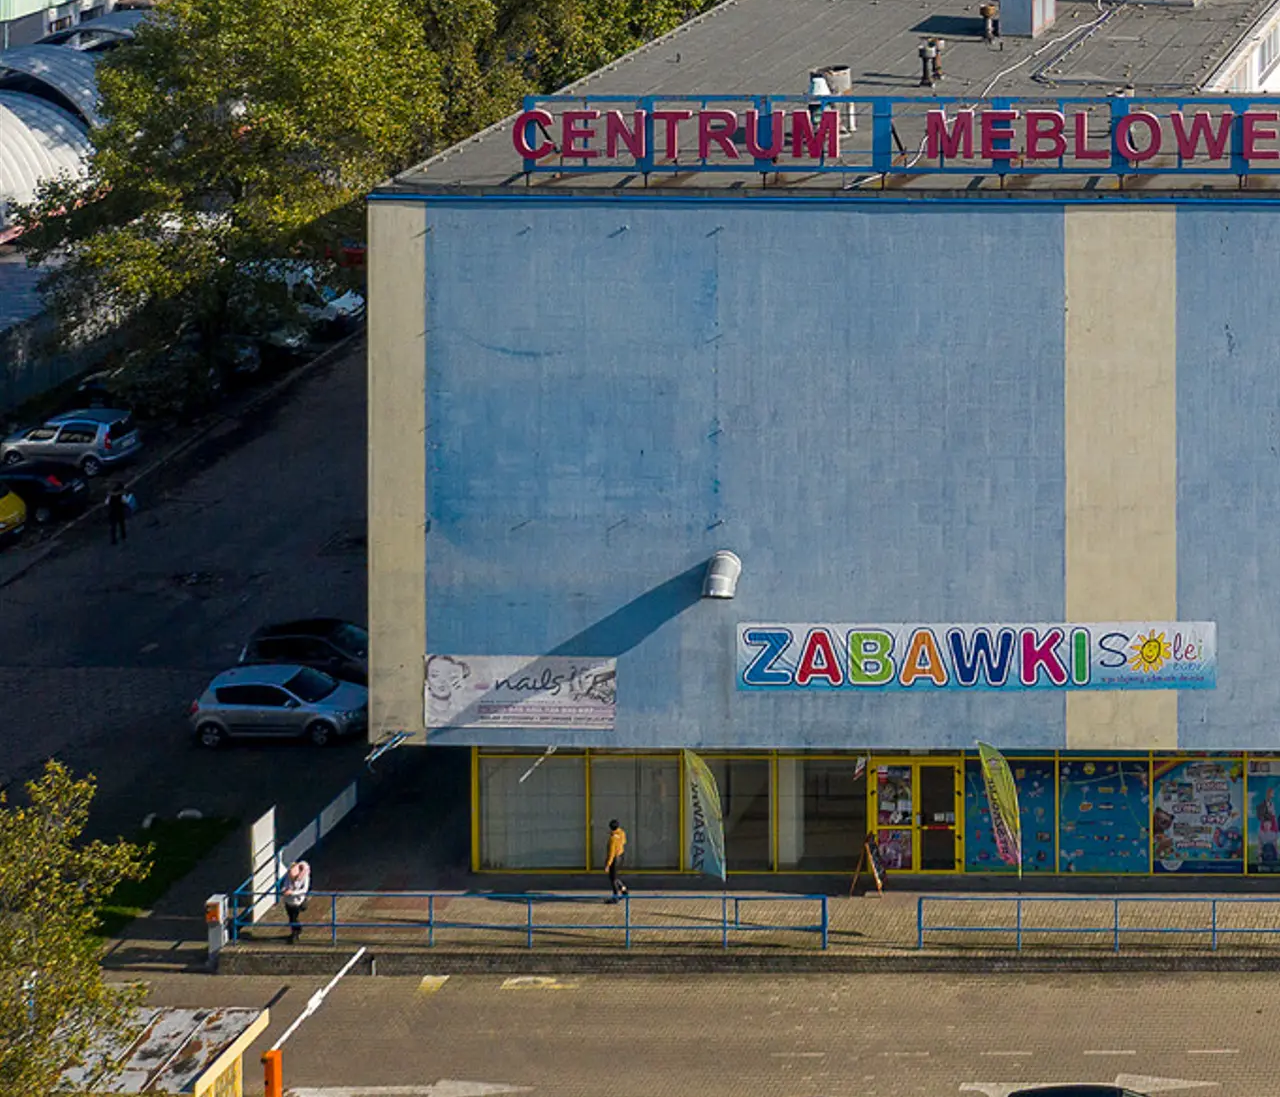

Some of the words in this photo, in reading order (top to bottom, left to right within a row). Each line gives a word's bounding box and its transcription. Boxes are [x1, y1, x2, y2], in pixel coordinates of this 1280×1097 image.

[512, 109, 841, 160] CENTRUM
[927, 110, 1280, 160] MEBLOWE
[743, 626, 1093, 687] ZABAWKI
